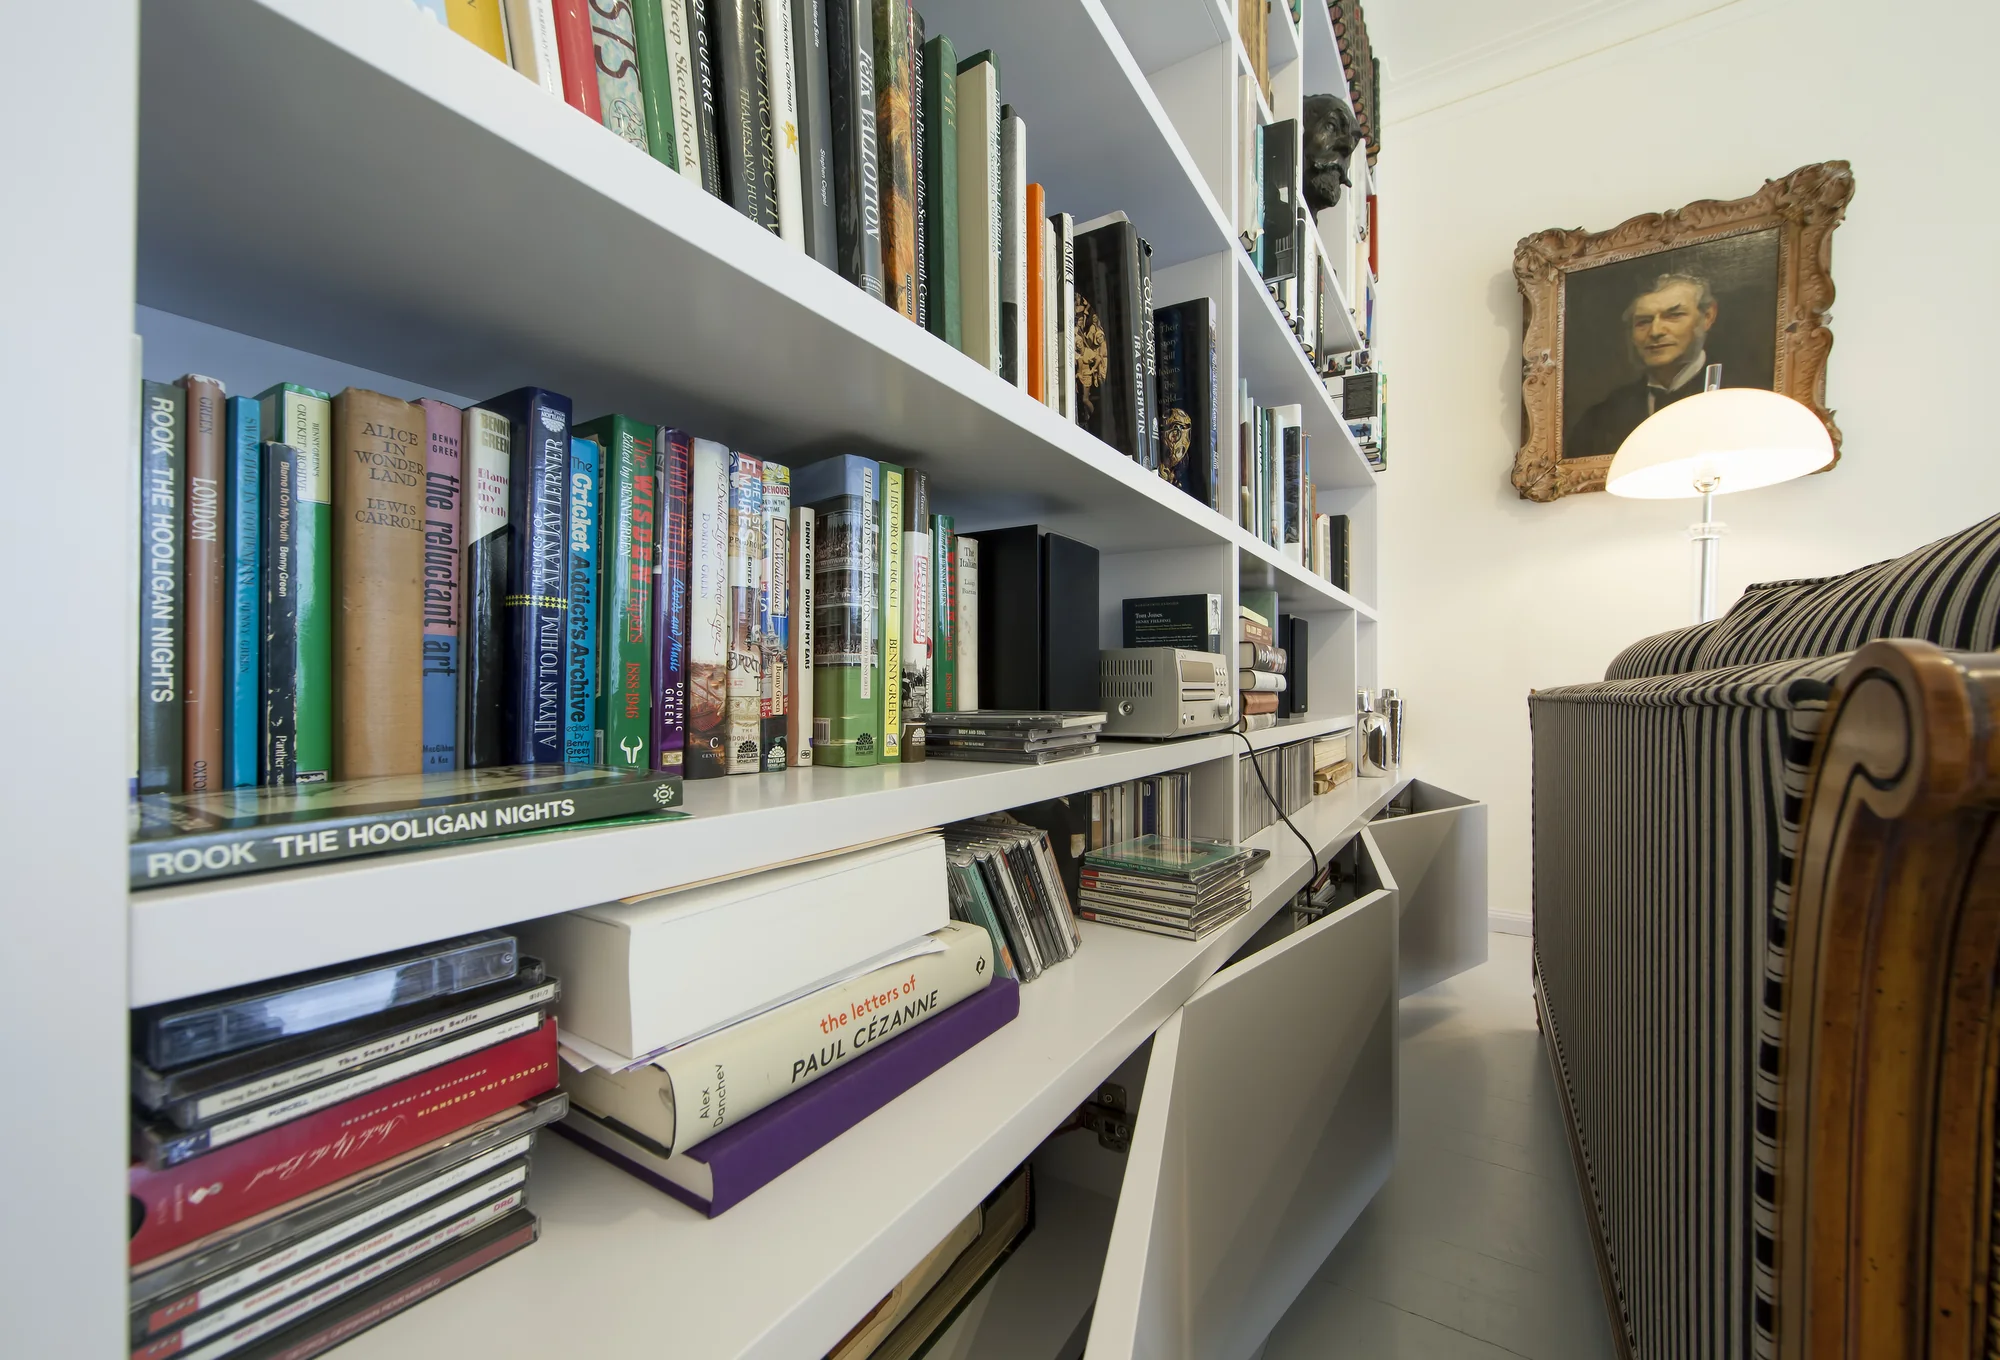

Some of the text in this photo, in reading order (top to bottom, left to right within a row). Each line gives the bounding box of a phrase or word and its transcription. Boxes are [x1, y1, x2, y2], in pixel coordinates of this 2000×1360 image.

[697, 30, 714, 115] GUERRE
[782, 16, 793, 113] Unknown Craftsman
[675, 52, 697, 168] Sketchbook
[739, 88, 755, 181] THAMES AND
[859, 46, 880, 241] Félix VALLOTTON
[913, 49, 928, 280] The French Painters of the Seventeenth
[1144, 276, 1156, 376] COLE PORTER
[1136, 360, 1146, 434] GERSHWIN
[297, 404, 308, 492] CRICKET ARCHIVE
[362, 422, 418, 446] ALICE
[384, 441, 406, 457] IN
[432, 432, 458, 447] BENNY
[432, 446, 458, 459] GREEN
[280, 462, 290, 486] Blame
[354, 450, 425, 476] WONDER
[369, 468, 417, 487] LAND
[538, 438, 563, 506] LERNER
[572, 457, 593, 472] The
[715, 460, 726, 484] The
[192, 476, 217, 542] LONDON
[243, 489, 256, 506] IN
[278, 508, 290, 520] My
[280, 494, 290, 506] On
[366, 498, 416, 515] LEWIS
[620, 432, 633, 558] Edited by BENNY GREEN
[668, 442, 688, 571] BENNY GREEN
[716, 484, 728, 523] Double
[738, 458, 756, 541] EMPIRES
[750, 476, 762, 532] THE LAST
[280, 520, 290, 542] Youth
[355, 510, 424, 532] CARROLL
[533, 514, 542, 528] OF
[537, 508, 562, 537] JAY
[626, 438, 652, 643] The WISDEN Papers
[712, 526, 727, 552] Life
[890, 477, 898, 608] A HISTORY OF CRICKET
[152, 396, 174, 703] ROOK THE HOOLIGAN NIGHTS
[533, 536, 542, 566] LYRICS
[542, 541, 561, 589] ALAN
[701, 513, 710, 600] DOMINIC GREEN
[864, 472, 872, 622] THE LORD'S COMPANION
[278, 546, 289, 597] Benny Green
[423, 471, 460, 677] the reluctant art
[714, 568, 726, 609] Doctor
[570, 473, 594, 723] Cricket Addict's Archive
[668, 578, 684, 672] Words and Music
[707, 611, 724, 656] Lopez
[805, 620, 810, 630] IN
[805, 633, 810, 646] MY
[534, 616, 559, 748] A HYMN TO HIM
[626, 662, 640, 718] 1888-1946
[774, 666, 782, 689] Benny
[888, 638, 898, 726] BENNY GREEN
[665, 688, 674, 725] GREEN
[676, 682, 684, 732] DOMINIC
[275, 736, 288, 768] Panther
[566, 740, 590, 748] Benny
[566, 747, 590, 755] Green
[574, 732, 584, 740] by
[438, 756, 448, 764] Kee
[147, 799, 576, 878] ROOK THE HOOLIGAN NIGHTS
[820, 974, 917, 1035] the letters of
[338, 1055, 358, 1066] The
[363, 1041, 395, 1059] Songs
[400, 1035, 410, 1045] of
[413, 1025, 444, 1042] Irving
[448, 1013, 478, 1028] Berlin
[791, 990, 940, 1084] PAUL CÉZANNE
[433, 1070, 486, 1090] CONDUCTED
[479, 1081, 497, 1092] IRA
[509, 1062, 547, 1080] GEORGE
[416, 1091, 475, 1115] GERSHWIN
[700, 1087, 710, 1120] Alex
[713, 1064, 725, 1128] Danchev
[244, 1130, 355, 1195] Up the Band
